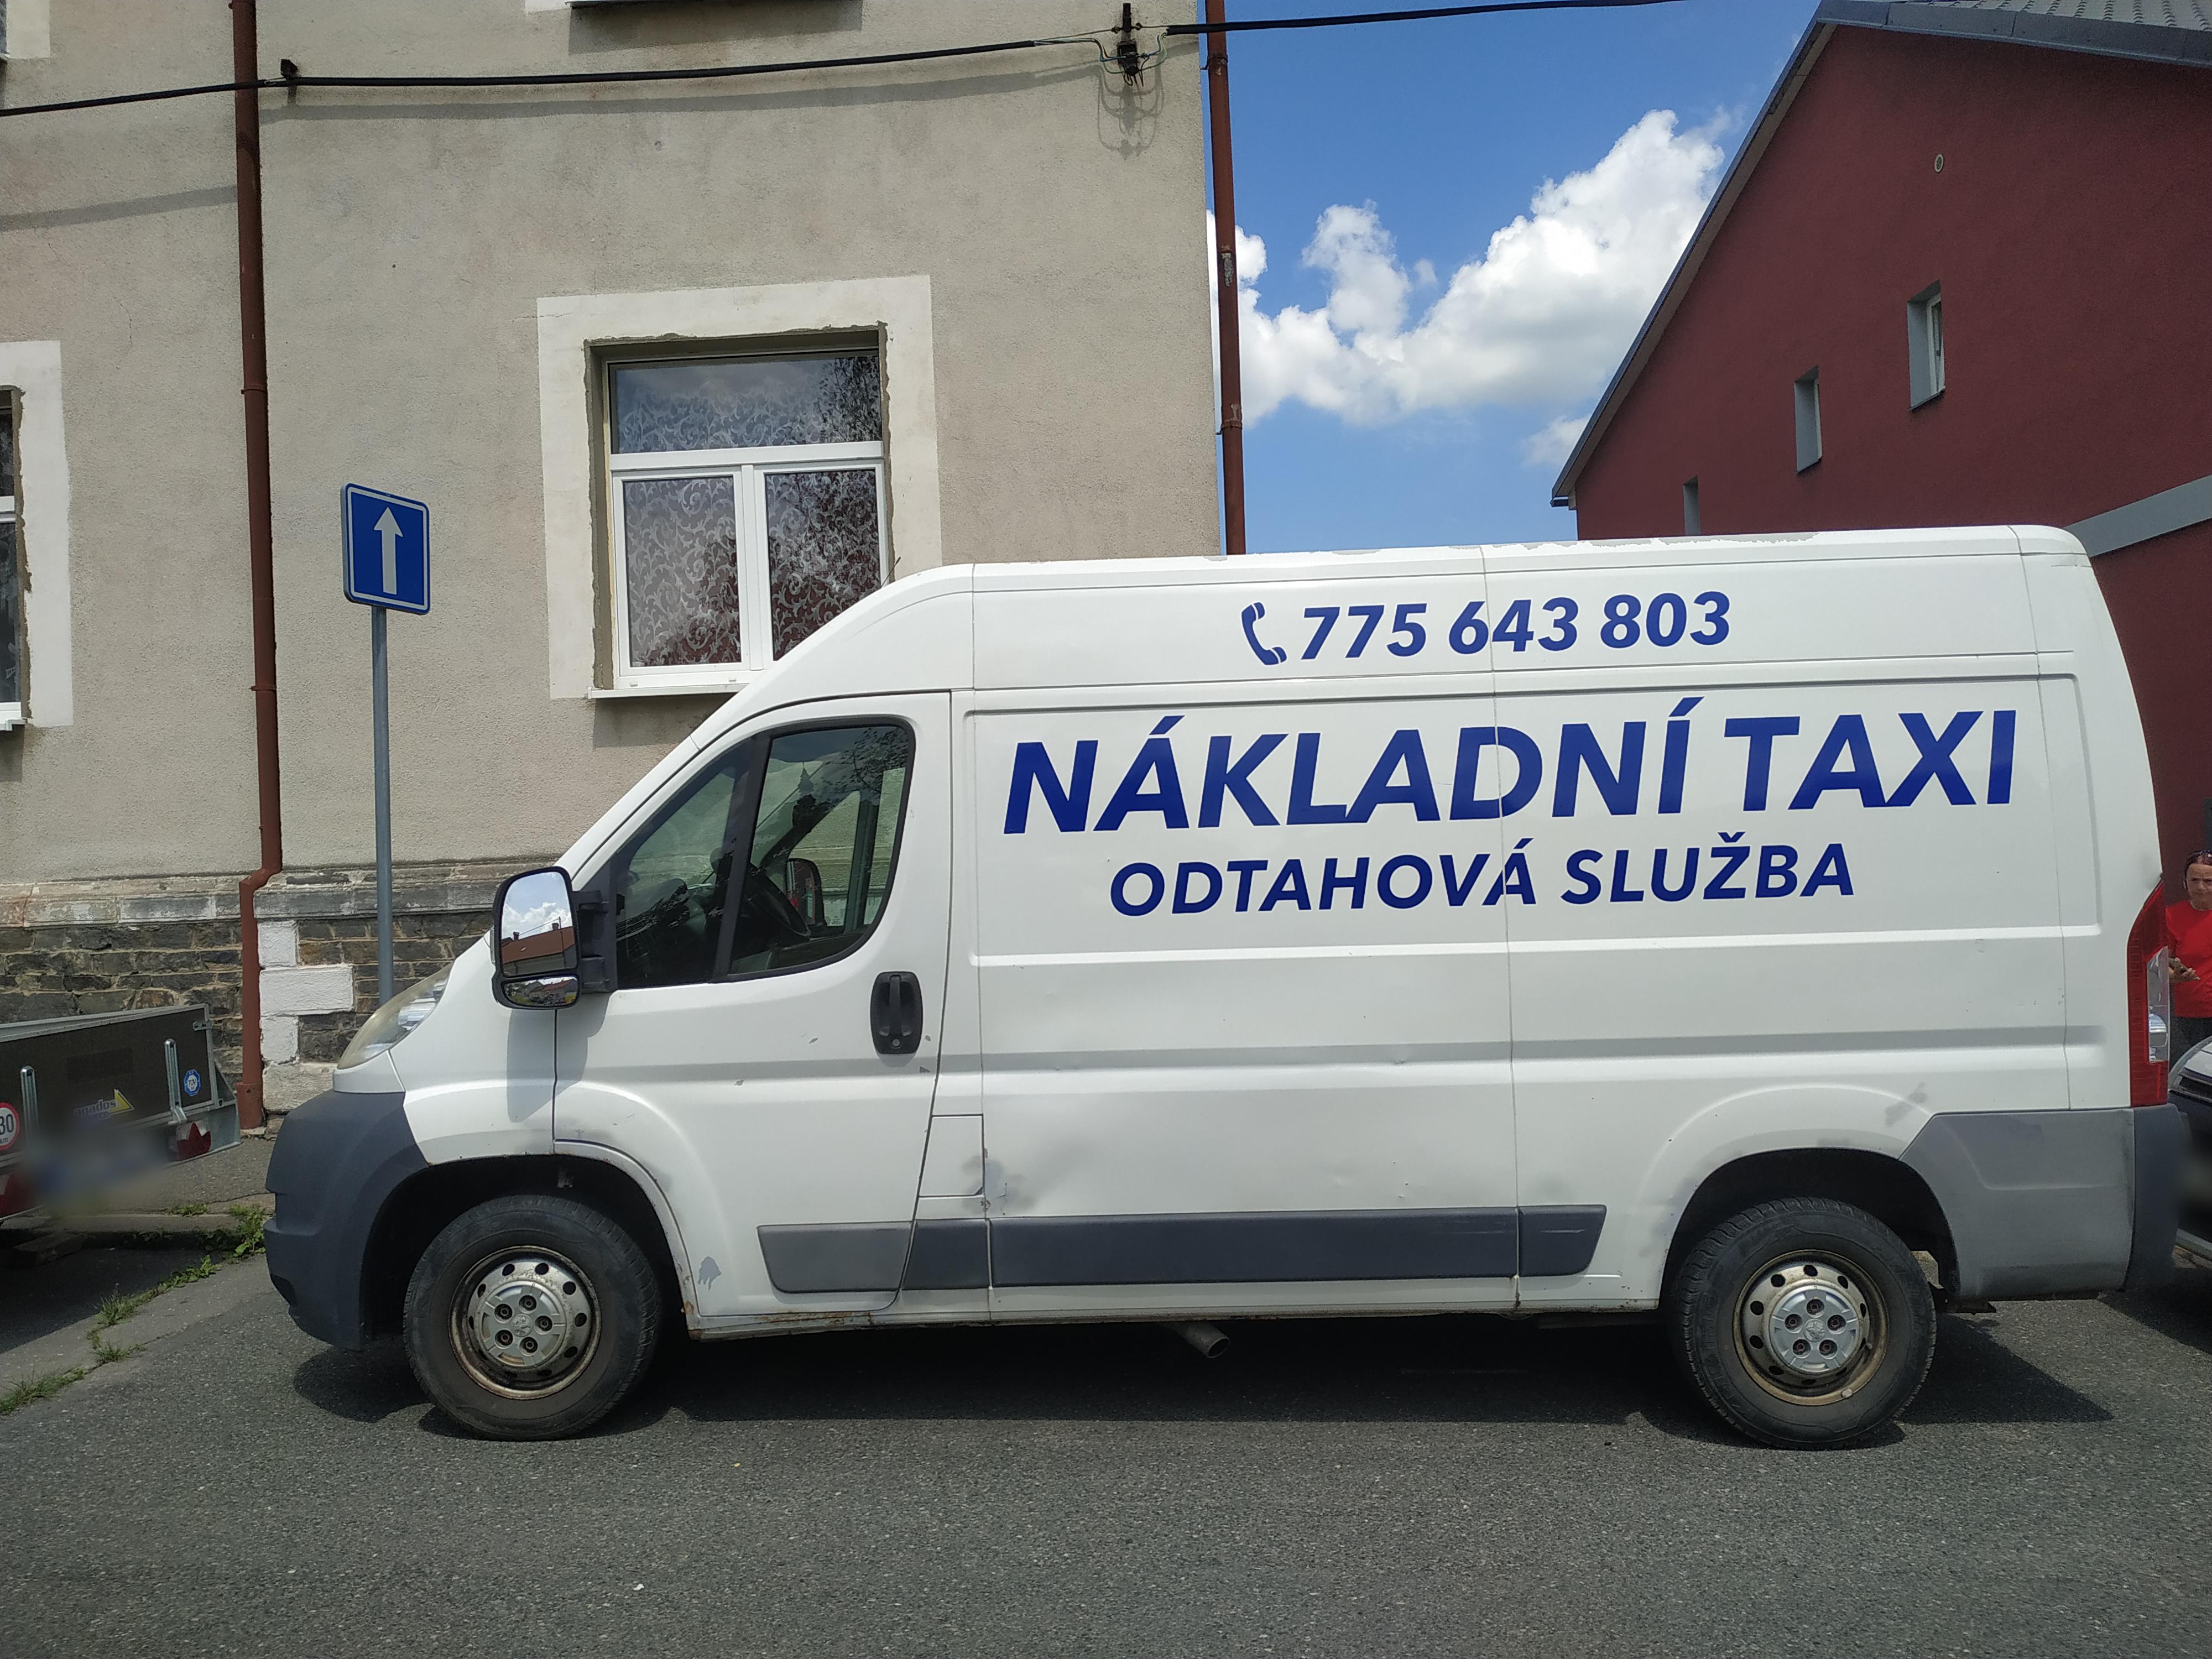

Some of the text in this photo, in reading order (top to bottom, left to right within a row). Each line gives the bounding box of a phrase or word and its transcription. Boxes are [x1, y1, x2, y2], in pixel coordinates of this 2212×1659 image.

[1302, 591, 1730, 660] 775 643 803
[1004, 696, 2017, 834] NÁKLADNÍ TAXI
[1110, 831, 1854, 917] ODTAHOVÁ SLUŽBA
